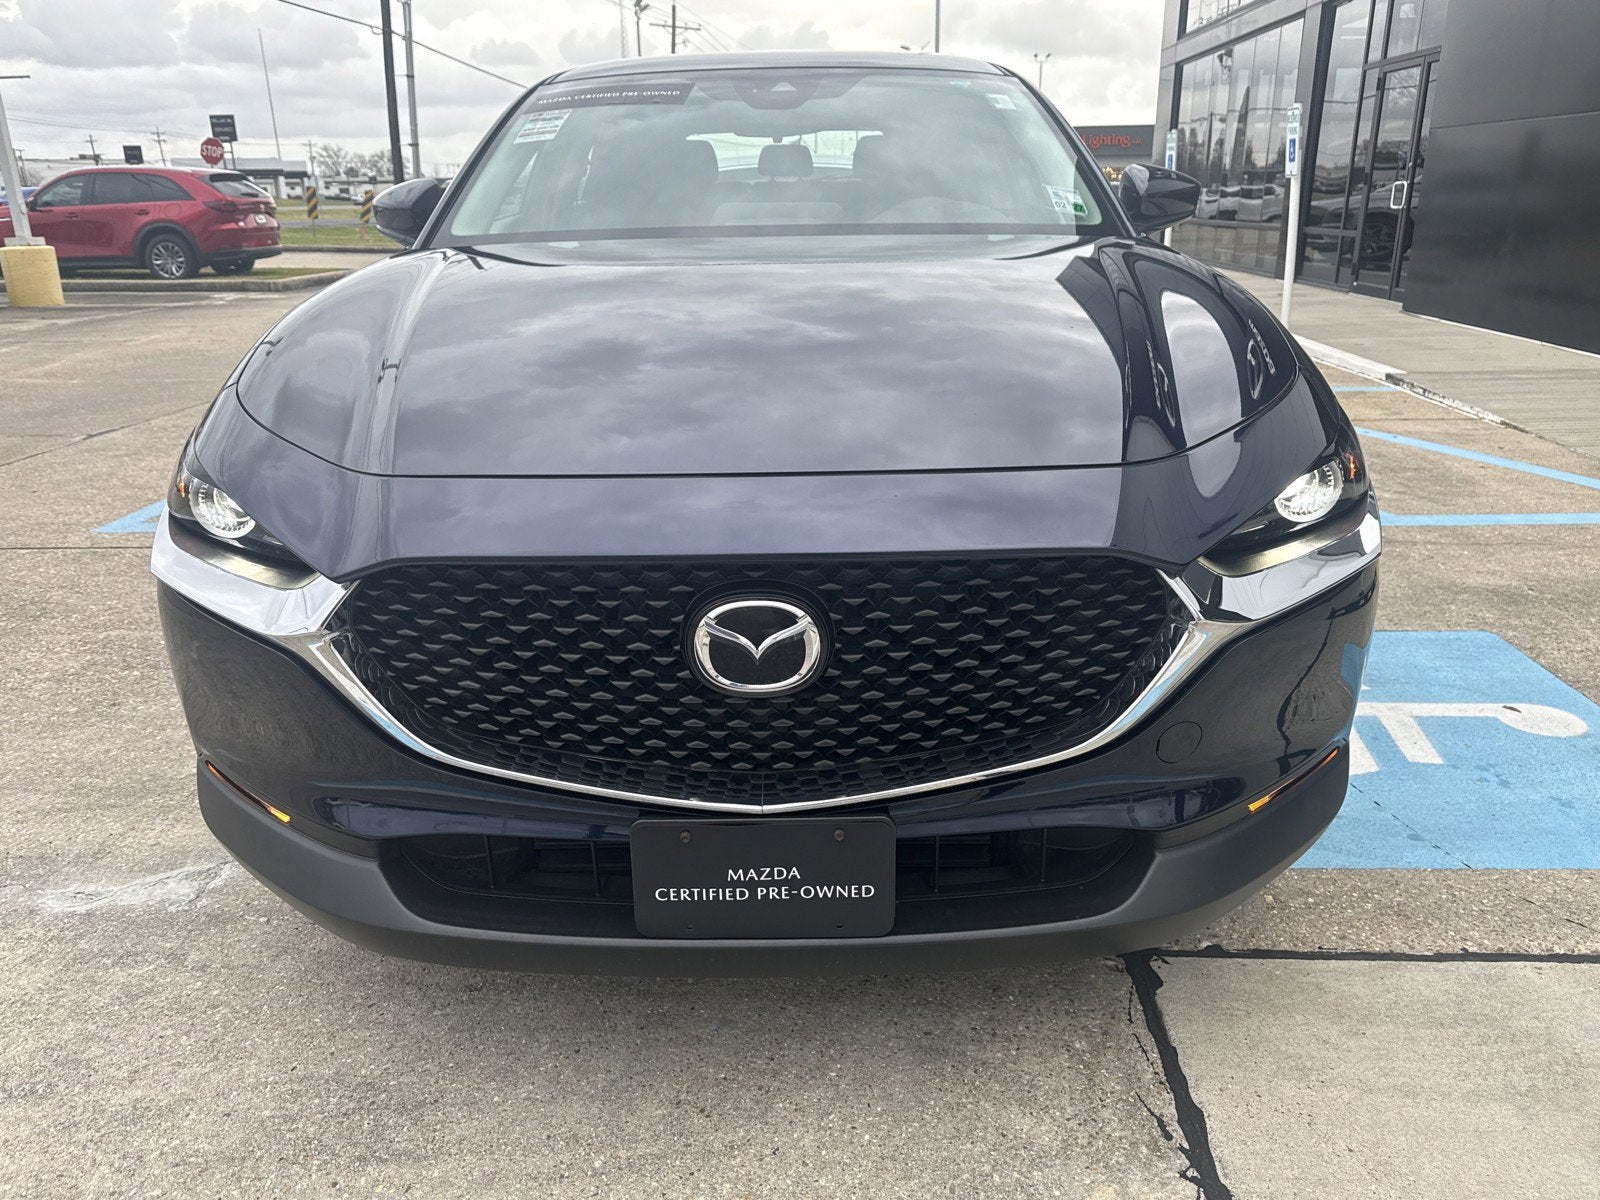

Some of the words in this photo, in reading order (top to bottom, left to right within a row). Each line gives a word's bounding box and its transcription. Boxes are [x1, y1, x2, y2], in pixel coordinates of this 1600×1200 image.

[538, 96, 571, 104] MAZDA
[1083, 134, 1131, 148] Lighting
[202, 145, 223, 157] STOP
[727, 866, 801, 882] MAZDA
[655, 887, 749, 901] CERTIFIED
[757, 884, 875, 899] PRE-OWNED
